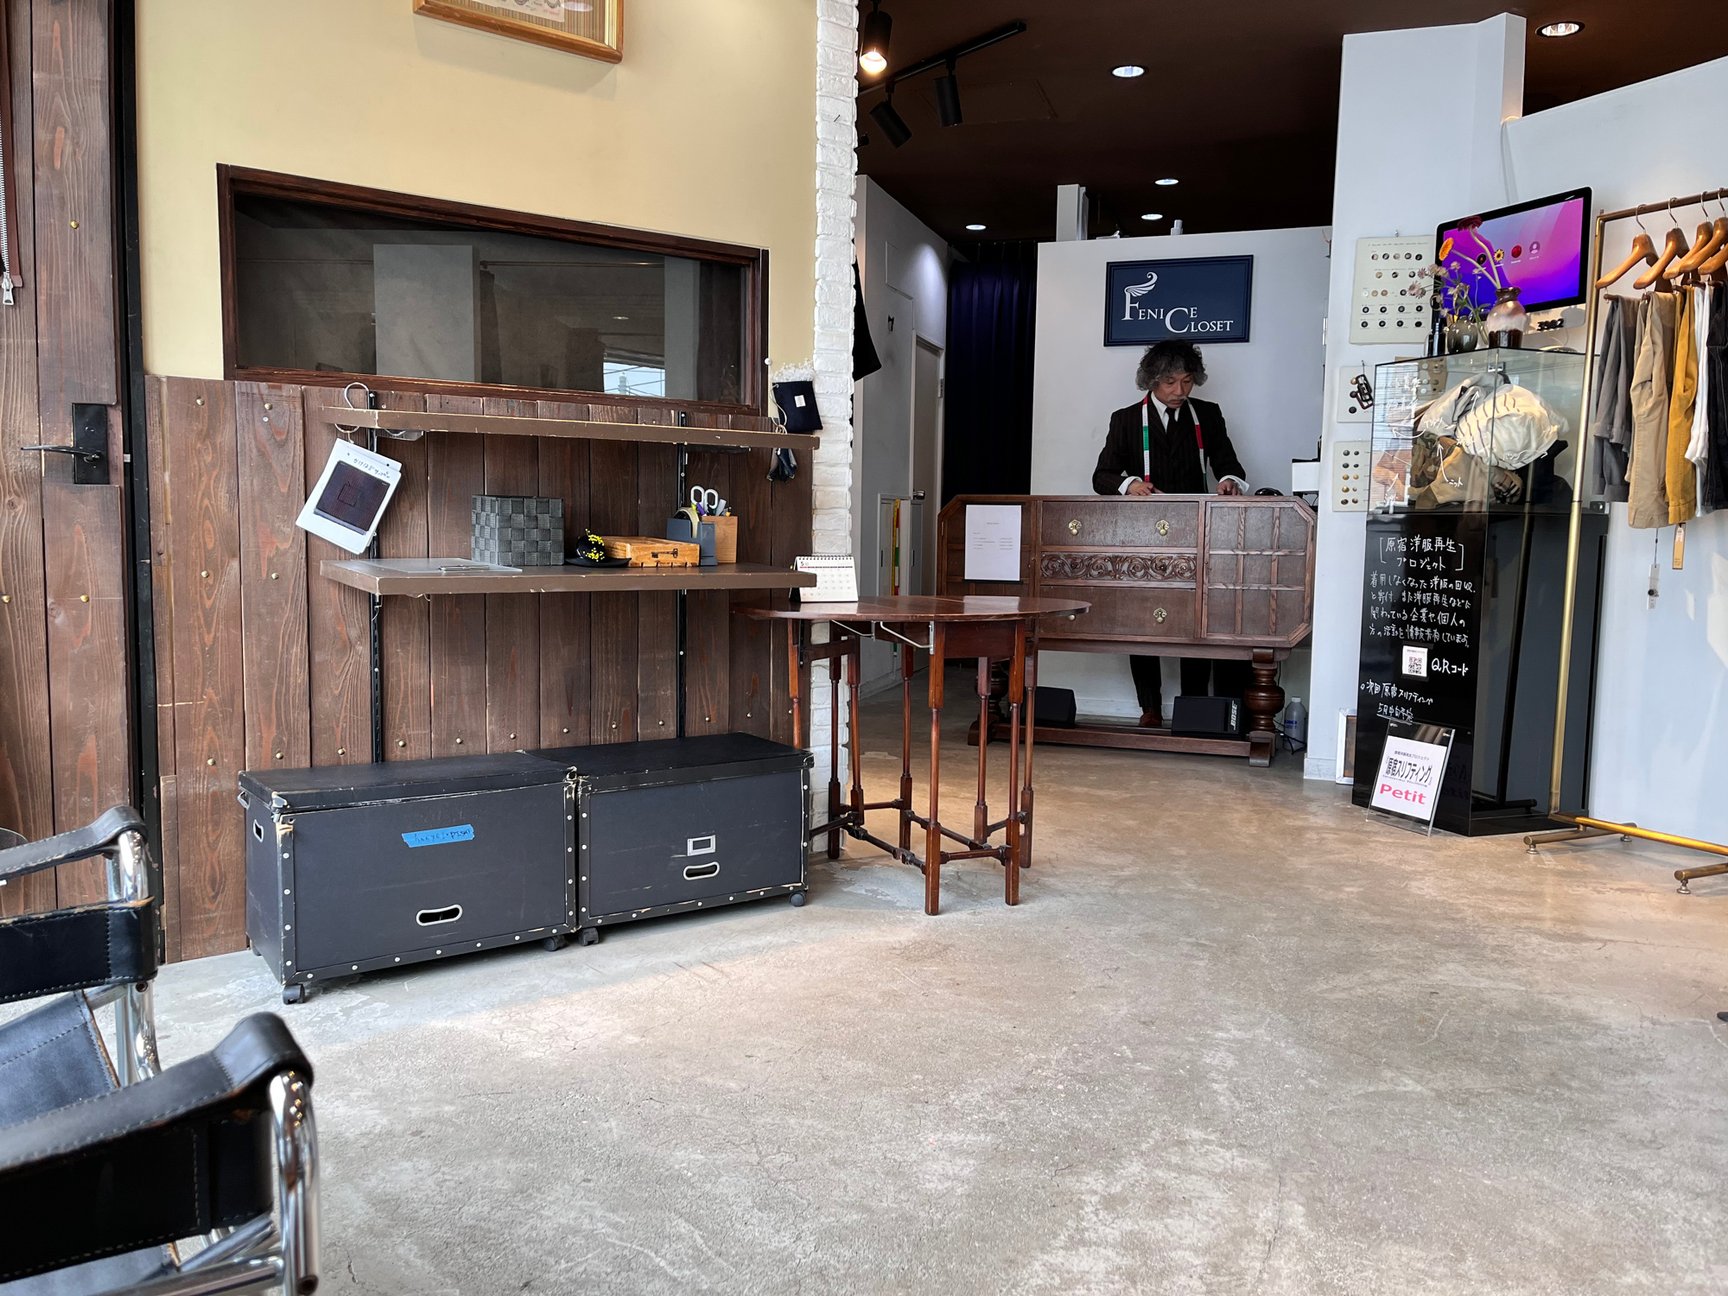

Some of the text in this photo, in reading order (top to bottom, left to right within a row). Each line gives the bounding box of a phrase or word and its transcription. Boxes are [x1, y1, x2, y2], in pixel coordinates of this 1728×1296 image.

[1121, 272, 1198, 333] FENICE
[1431, 657, 1469, 677] QRコード
[1230, 699, 1238, 731] BOSE
[1379, 783, 1427, 805] Petit
